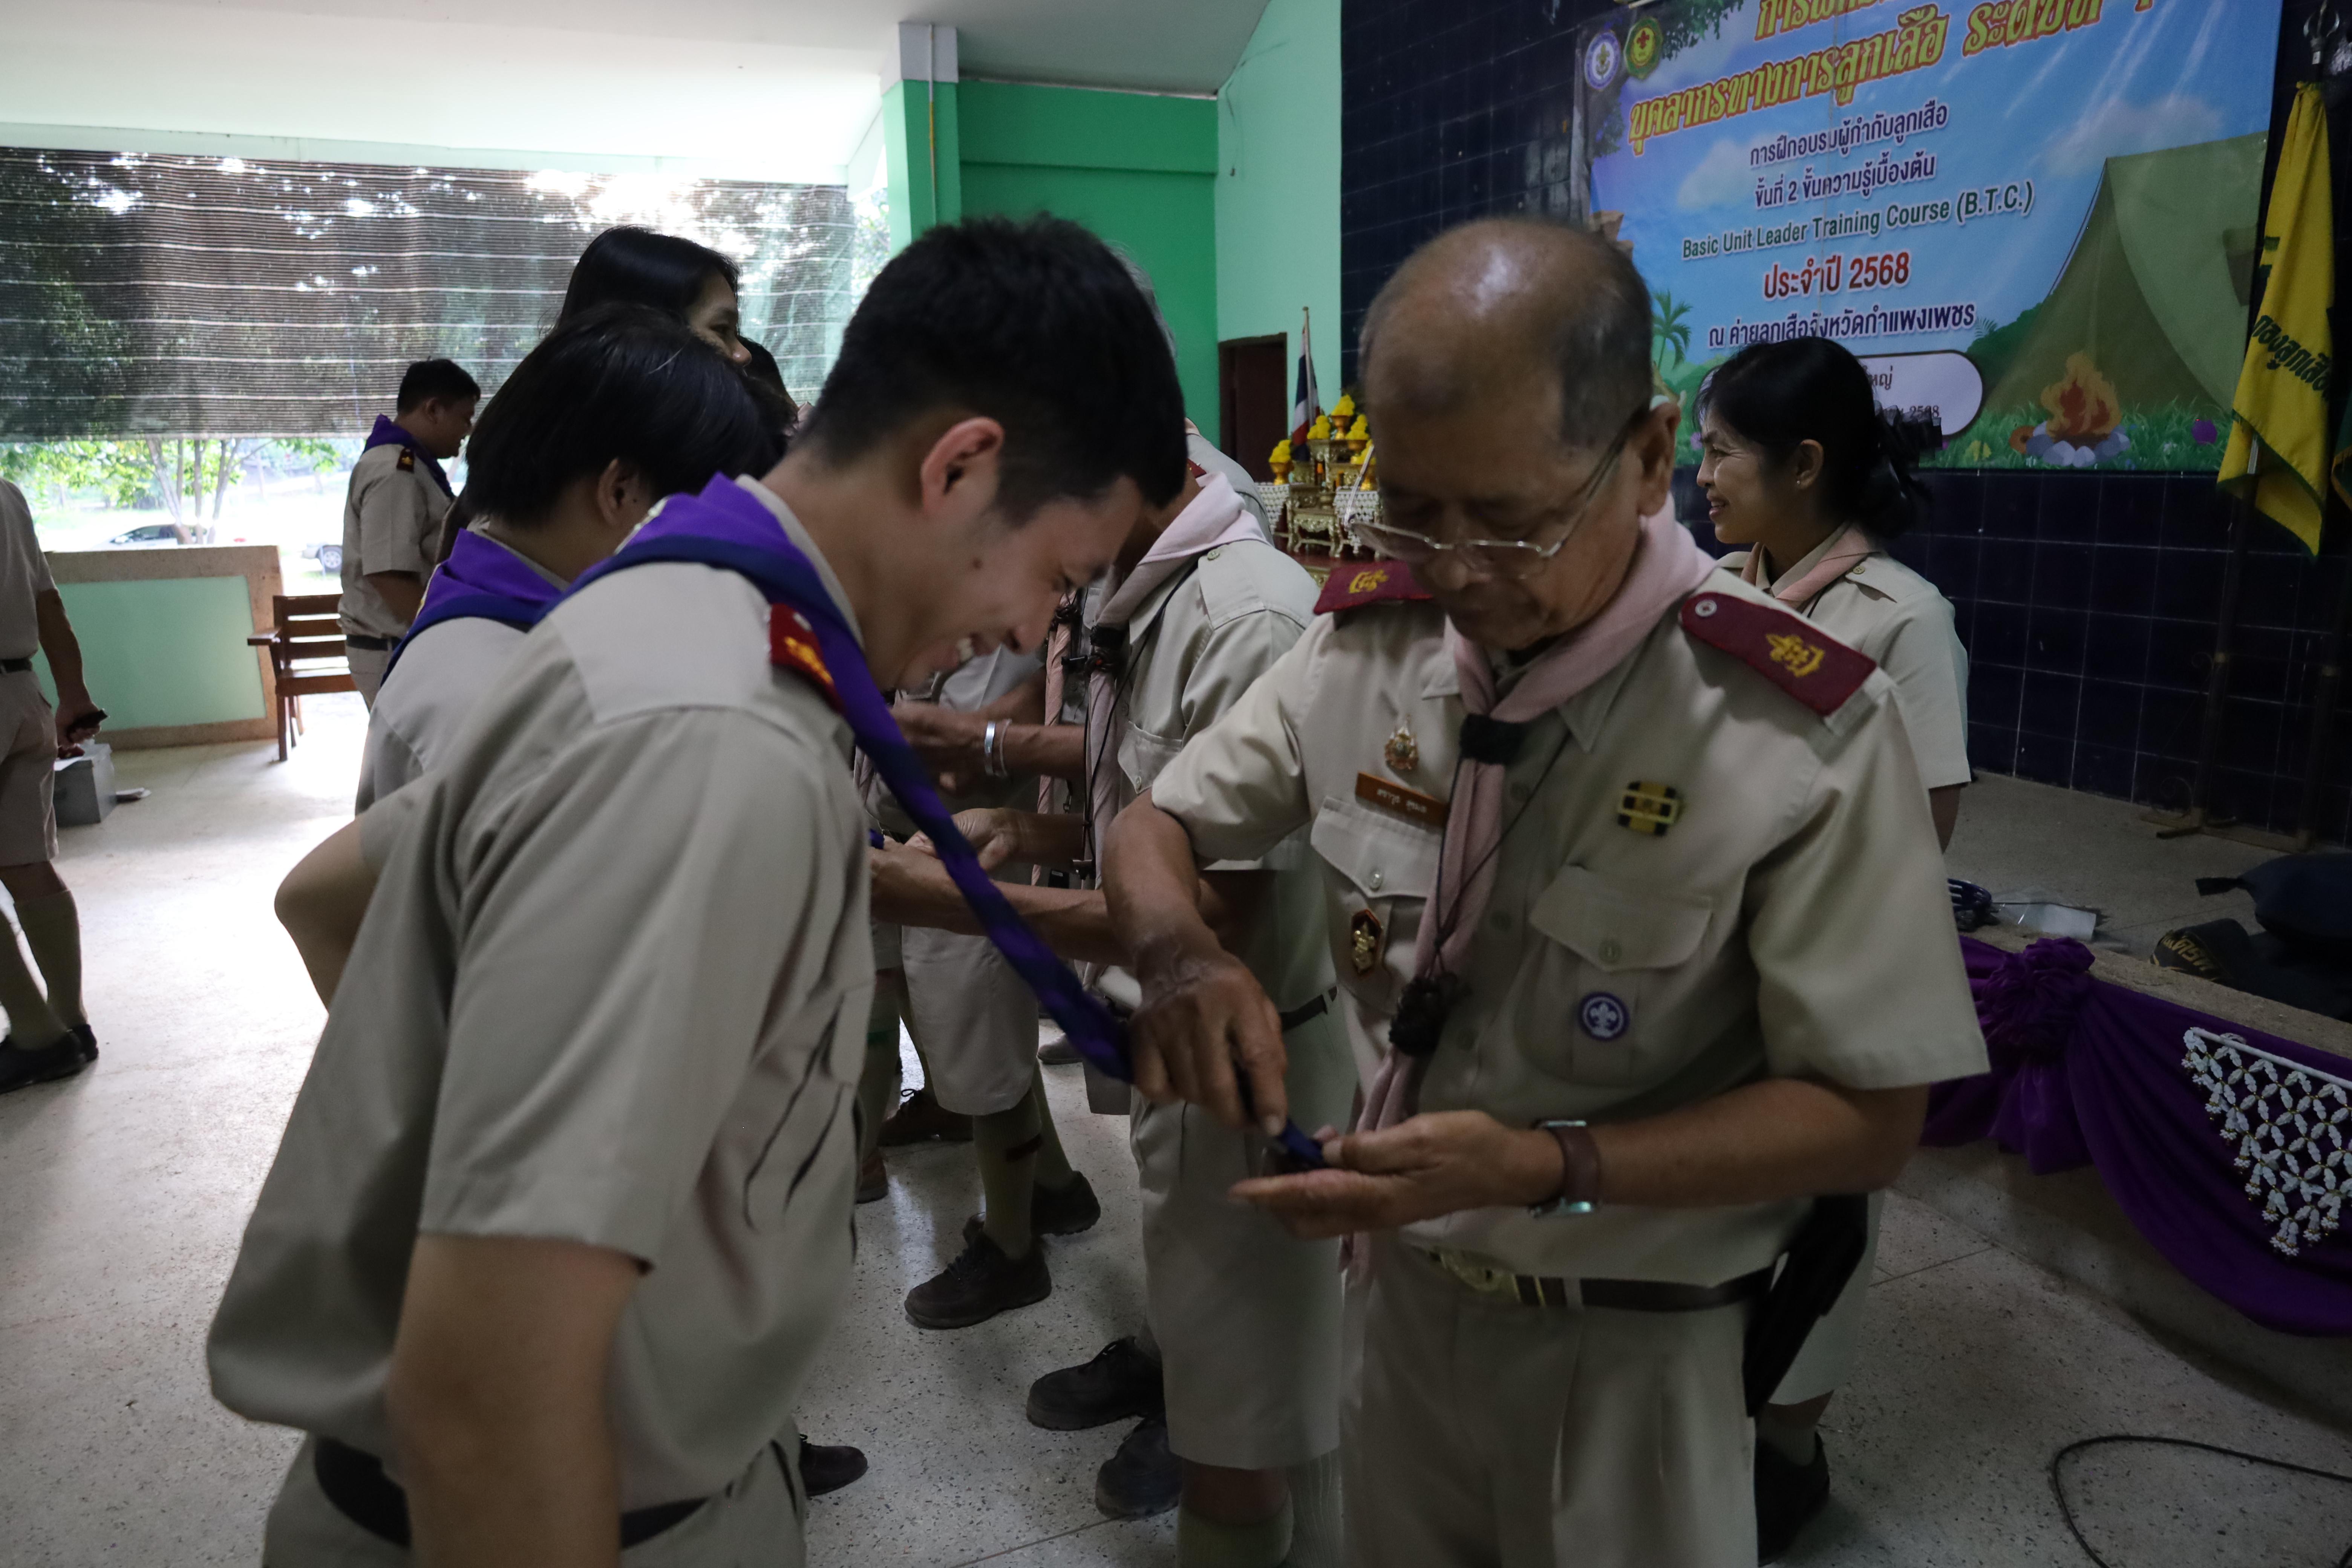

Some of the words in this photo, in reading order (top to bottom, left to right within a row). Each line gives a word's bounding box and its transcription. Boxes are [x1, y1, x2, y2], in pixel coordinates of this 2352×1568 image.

[1629, 4, 1949, 155] บุคลากรทางการลูกเสือ
[1750, 100, 1948, 165] การฝึกอบรมผู้กำกับลูกเสือ
[1756, 174, 1783, 207] ขั้นที่
[1788, 181, 1797, 201] 2
[1803, 151, 1935, 196] ขั้นความรู้เบื้องต้น
[1683, 235, 1718, 258] Basic
[1724, 229, 1752, 251] Unit
[1757, 222, 1807, 247] Leader
[1813, 211, 1880, 237] Training
[1888, 201, 1949, 226] Course
[1957, 181, 2032, 222] (B.T.C.)
[1765, 255, 1841, 298] ประจำปี
[1849, 252, 1909, 289] 2568
[1710, 328, 1724, 346] ณ
[1730, 304, 1975, 345] ค่ายลกเสือจังหวัดกำแพงเพชร
